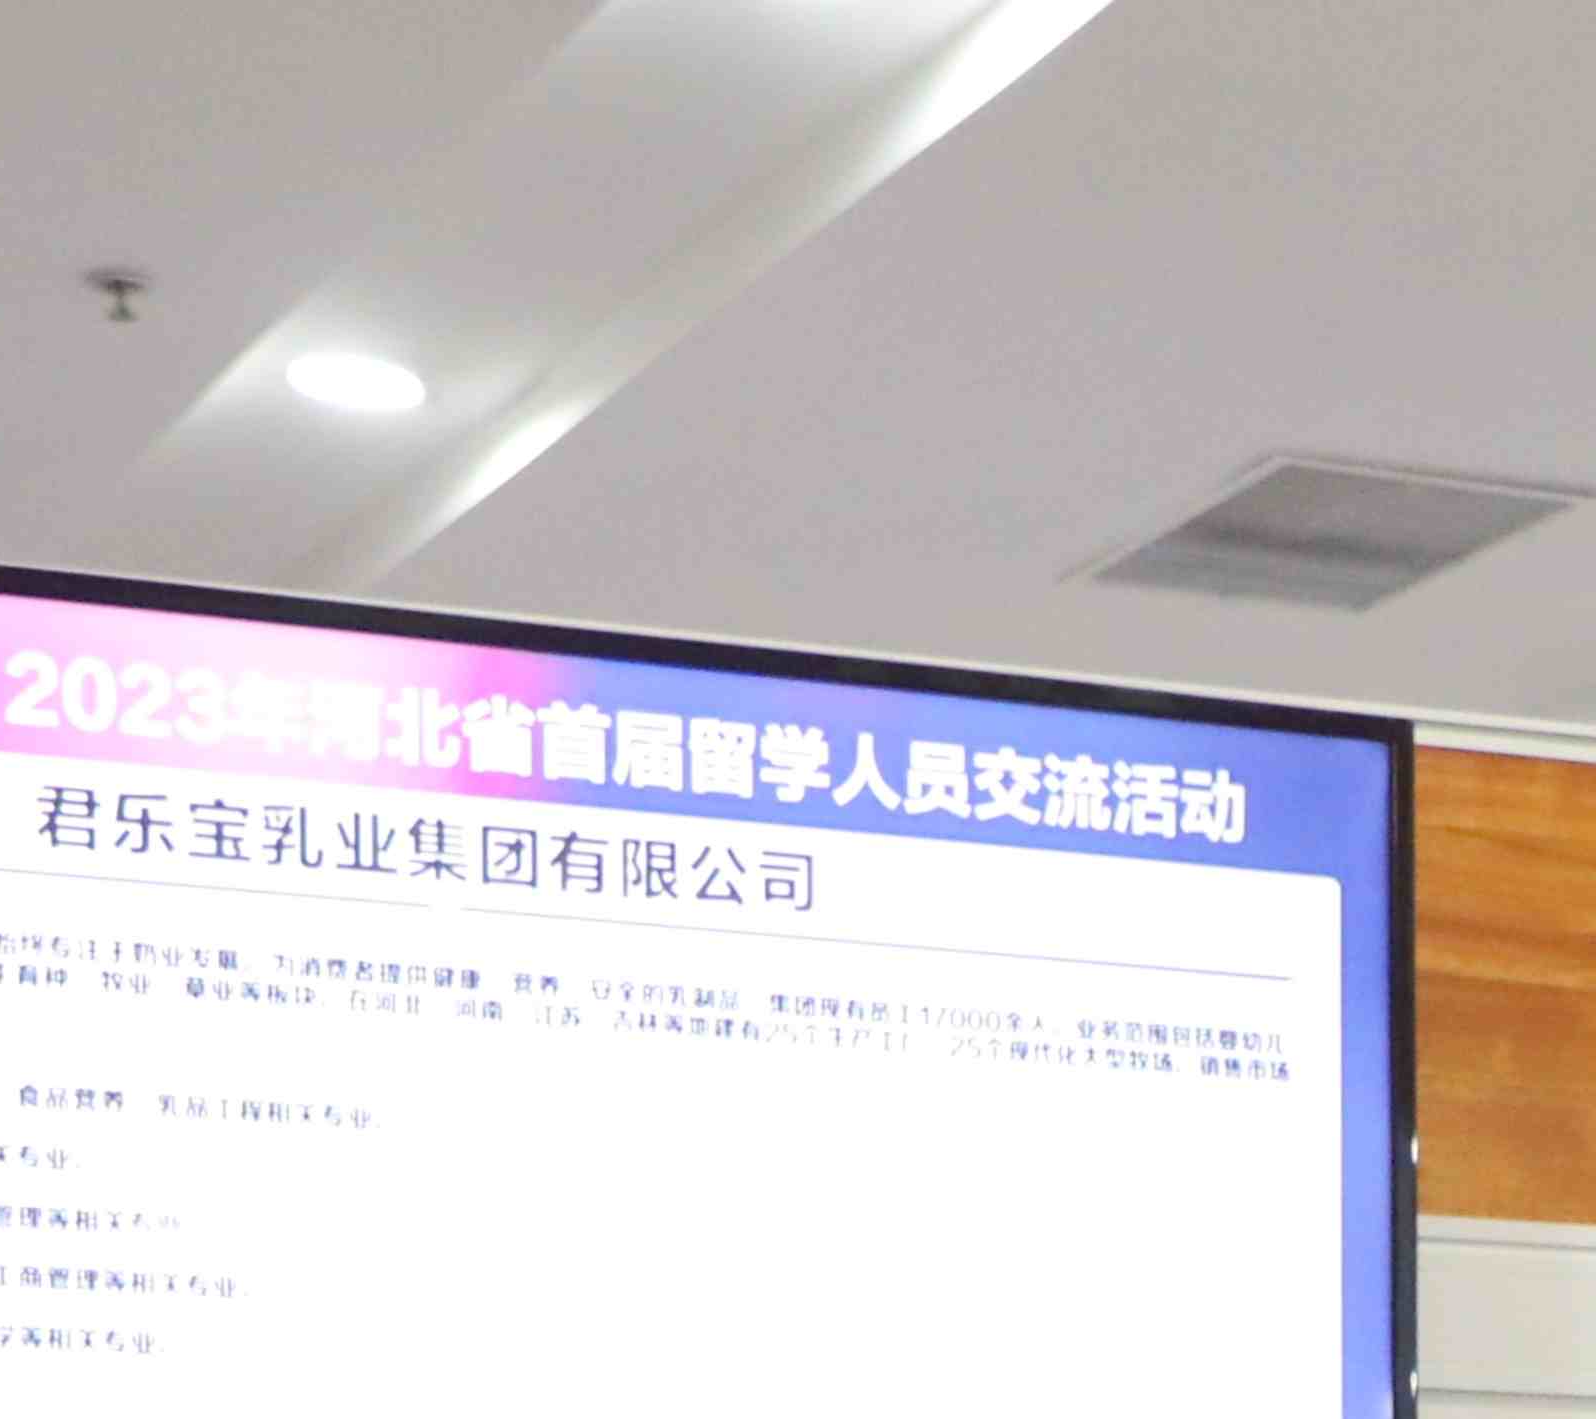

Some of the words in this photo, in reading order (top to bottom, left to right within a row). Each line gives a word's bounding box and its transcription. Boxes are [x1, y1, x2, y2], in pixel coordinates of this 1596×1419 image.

[37, 783, 819, 912] 君乐宝乳业集团有限公司
